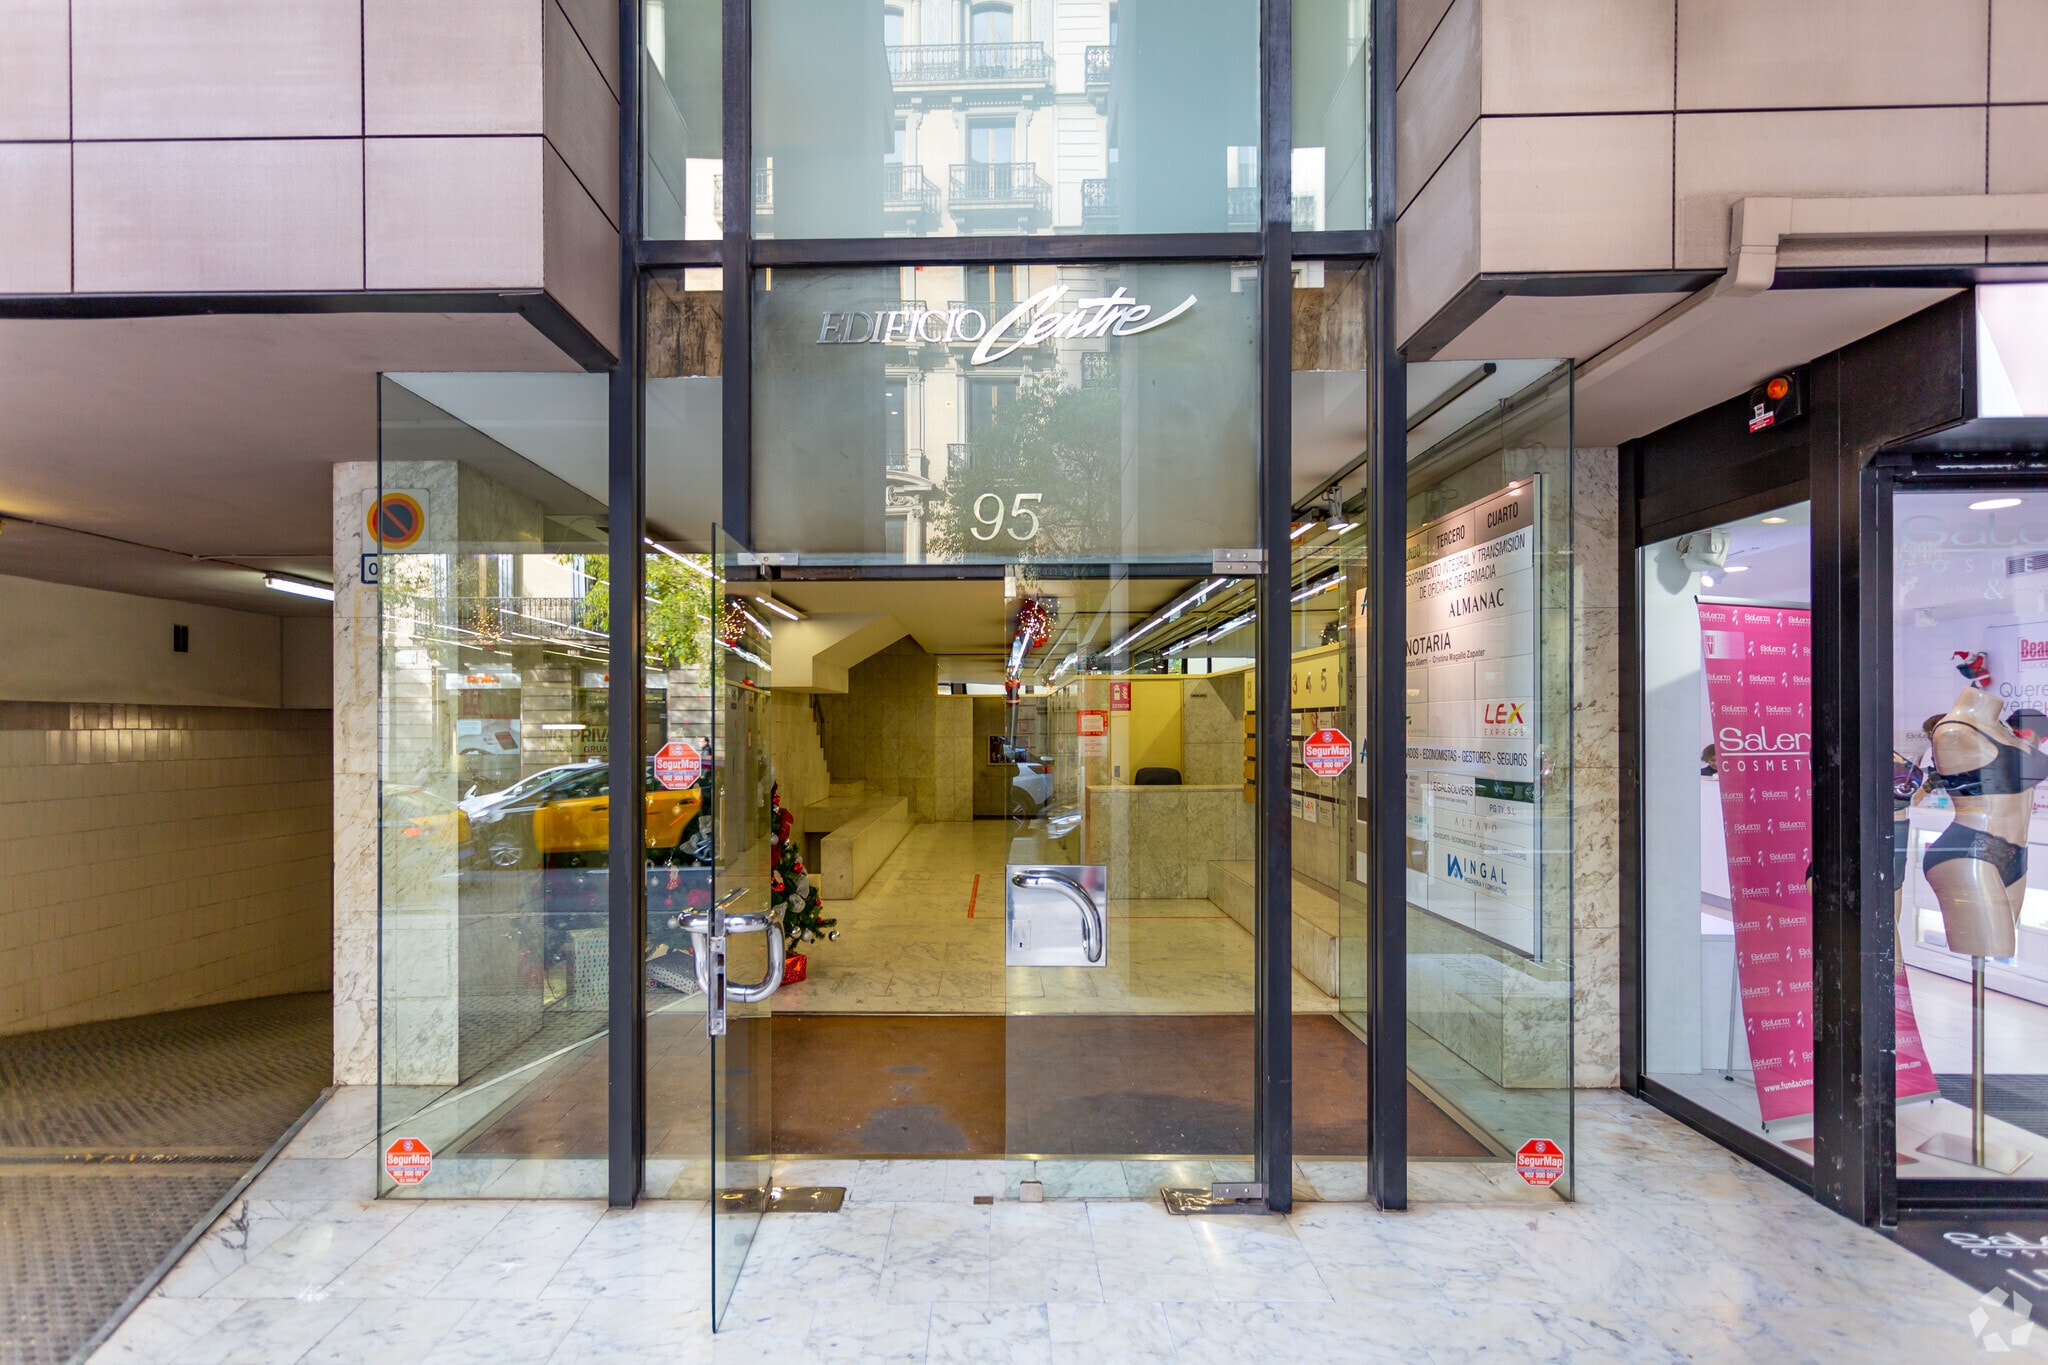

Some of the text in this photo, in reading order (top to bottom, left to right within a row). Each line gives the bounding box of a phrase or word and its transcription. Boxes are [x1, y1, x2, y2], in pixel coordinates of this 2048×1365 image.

[816, 283, 1197, 366] EDIFICIO Centre
[970, 492, 1043, 541] 95
[1487, 502, 1519, 529] CUARTO
[1436, 525, 1466, 549] TERCERO
[1441, 553, 1471, 575] INTEGRAL
[1472, 553, 1477, 564] Y
[1478, 532, 1526, 562] TRANSMISIÓN
[1419, 585, 1427, 599] DE
[1454, 575, 1462, 588] DE
[1463, 564, 1497, 585] FARMACIA
[1984, 579, 2005, 600] &
[1449, 588, 1504, 618] ALMANAC
[1406, 632, 1451, 656] NOTARIA
[1292, 672, 1298, 695] 3
[1306, 672, 1312, 694] 4
[1321, 668, 1327, 693] 5
[1484, 701, 1528, 724] LEX
[1484, 728, 1524, 736] EXPRESS
[1306, 746, 1349, 757] SegurMap
[1423, 748, 1457, 762] ECONOMISTAS
[1462, 750, 1491, 764] GESTORES
[1496, 751, 1528, 767] SEGUROS
[657, 759, 699, 770] SegurMap
[1431, 781, 1474, 797] LEGALSOLVERS
[1464, 857, 1507, 886] INGAL
[387, 1154, 430, 1166] SegurMap
[1518, 1156, 1562, 1168] SegurMap
